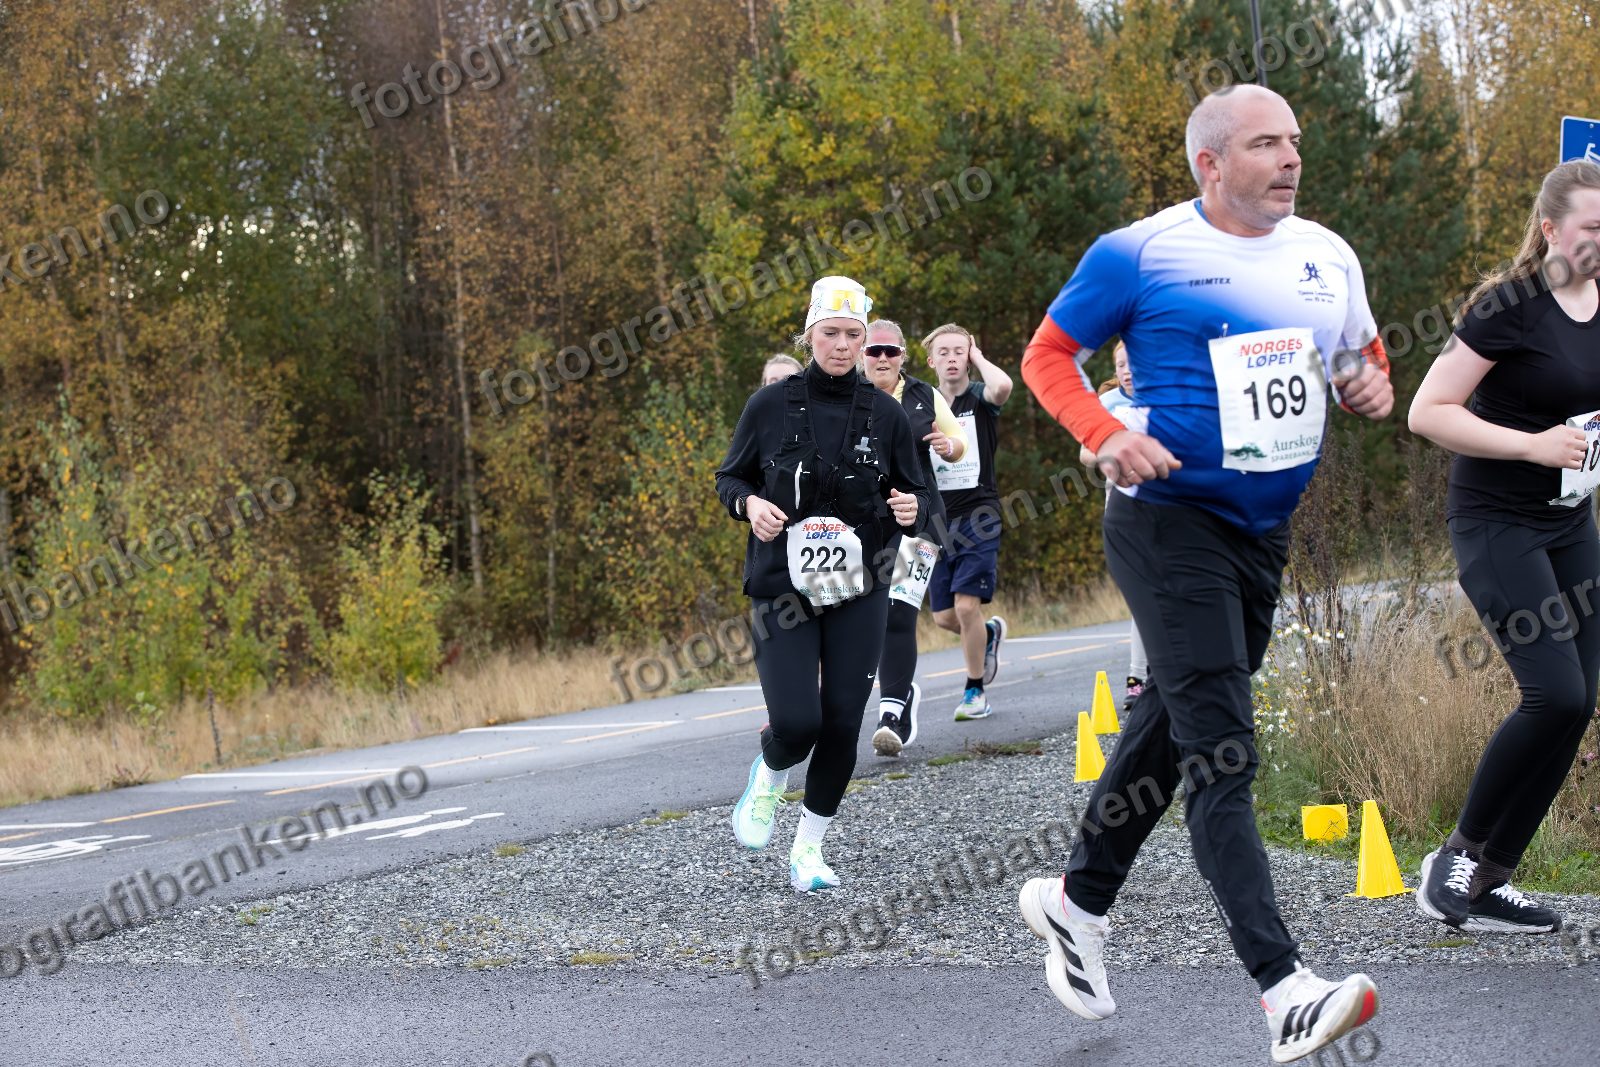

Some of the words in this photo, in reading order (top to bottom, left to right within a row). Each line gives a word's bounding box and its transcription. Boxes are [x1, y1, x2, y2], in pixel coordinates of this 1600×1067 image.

[1189, 277, 1231, 287] TRIMTEX
[1238, 338, 1303, 357] NORGES
[1247, 352, 1296, 369] LØPET
[1243, 375, 1307, 421] 169
[1271, 434, 1319, 452] Aurskog
[803, 523, 848, 532] NORGES
[805, 532, 841, 540] LØPET
[800, 546, 847, 574] 222
[907, 559, 931, 585] 154
[818, 584, 860, 595] Aurskog
